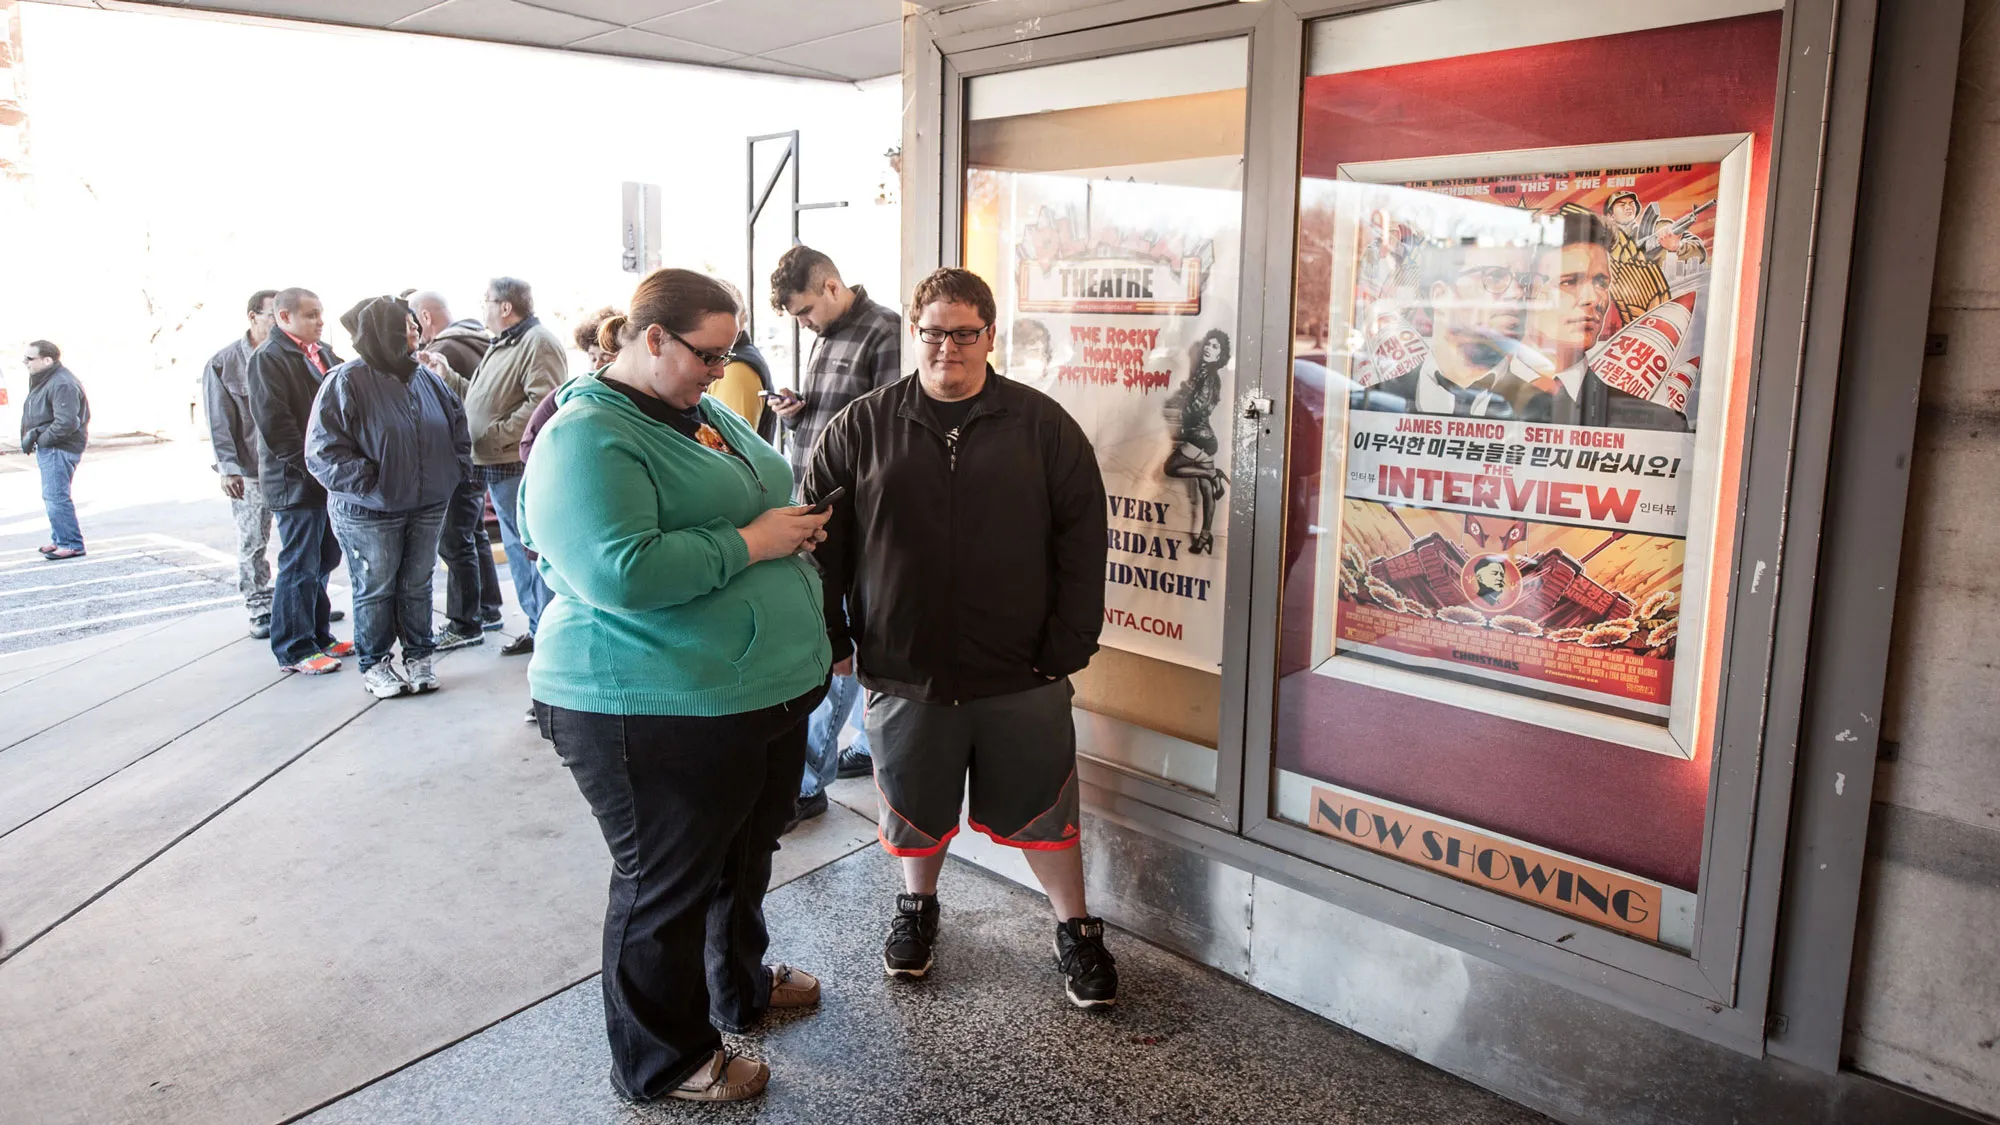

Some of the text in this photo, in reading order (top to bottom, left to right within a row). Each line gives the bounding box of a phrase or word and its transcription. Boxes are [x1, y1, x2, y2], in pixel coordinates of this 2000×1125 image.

[1494, 185, 1516, 194] AND
[1520, 181, 1549, 193] THIS
[1555, 180, 1569, 191] IS
[1575, 178, 1600, 189] THE
[1607, 176, 1636, 188] END
[1575, 170, 1600, 178] WHO
[1605, 166, 1660, 176] BROUGHT
[1667, 164, 1692, 172] YOU
[1058, 268, 1154, 299] THEATRE
[1070, 325, 1161, 351] THE ROCKY
[1083, 346, 1144, 370] HORROR
[1603, 335, 1668, 389] 전쟁은
[1058, 364, 1172, 395] PICTURE SHOW
[1395, 418, 1625, 449] JAMES FRANCO SETH ROGEN
[1426, 438, 1526, 465] 미국놈들을
[1530, 446, 1573, 469] 믿지
[1576, 450, 1681, 478] 마십시오!
[1482, 463, 1513, 476] THE
[1350, 470, 1376, 483] 인터뷰
[1378, 464, 1641, 524] INTERVIEW
[1639, 502, 1677, 515] 인터뷰
[1108, 495, 1170, 525] VERY
[1107, 528, 1182, 561] RIDAY
[1105, 560, 1211, 601] IDNIGHT
[1104, 607, 1183, 641] NTA.COM
[1452, 650, 1519, 671] CHRISTMAS
[1316, 797, 1649, 925] NOW SHOWING
